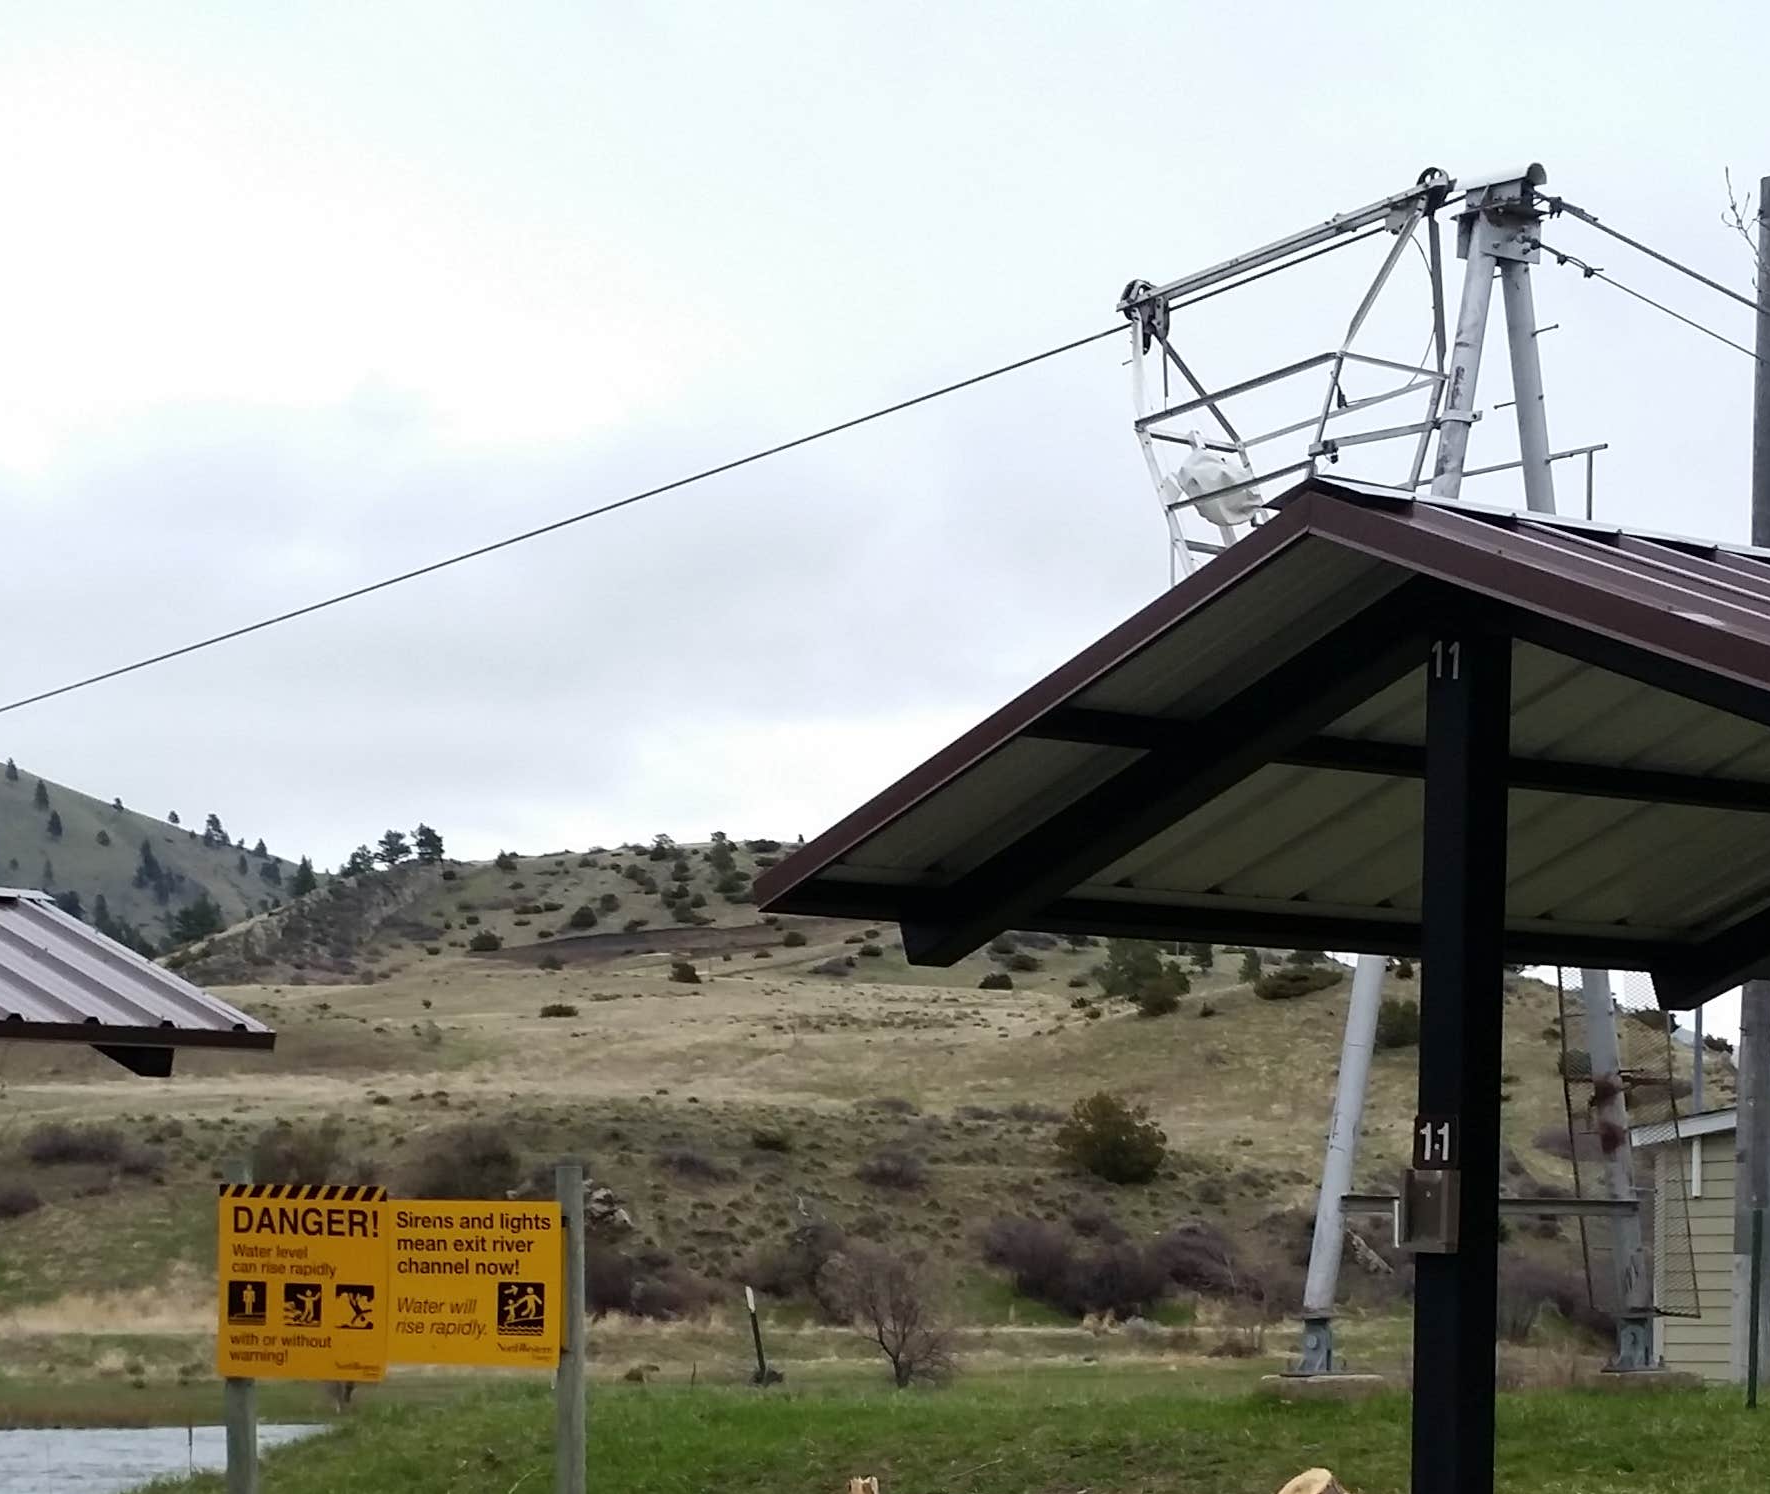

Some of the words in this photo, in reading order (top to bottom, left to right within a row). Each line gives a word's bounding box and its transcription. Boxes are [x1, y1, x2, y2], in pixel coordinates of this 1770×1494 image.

[1431, 640, 1460, 680] 11
[1419, 1121, 1450, 1162] 11
[233, 1206, 378, 1237] DANGER!
[396, 1211, 453, 1229] Sirens
[459, 1213, 494, 1230] and
[500, 1213, 551, 1233] lights
[232, 1244, 271, 1258] Water
[276, 1245, 309, 1259] level
[397, 1238, 447, 1251] mean
[453, 1236, 486, 1252] exit
[492, 1236, 534, 1252] river
[232, 1262, 257, 1273] can
[261, 1262, 286, 1274] rise
[290, 1263, 336, 1278] rapidly
[397, 1257, 469, 1274] channel
[475, 1259, 519, 1275] now!
[397, 1297, 445, 1314] Water
[449, 1298, 478, 1314] will
[395, 1320, 424, 1334] rise
[429, 1321, 487, 1340] rapidly.
[230, 1334, 259, 1345] with
[263, 1336, 277, 1346] or
[281, 1335, 332, 1348] without
[230, 1350, 288, 1366] warning!
